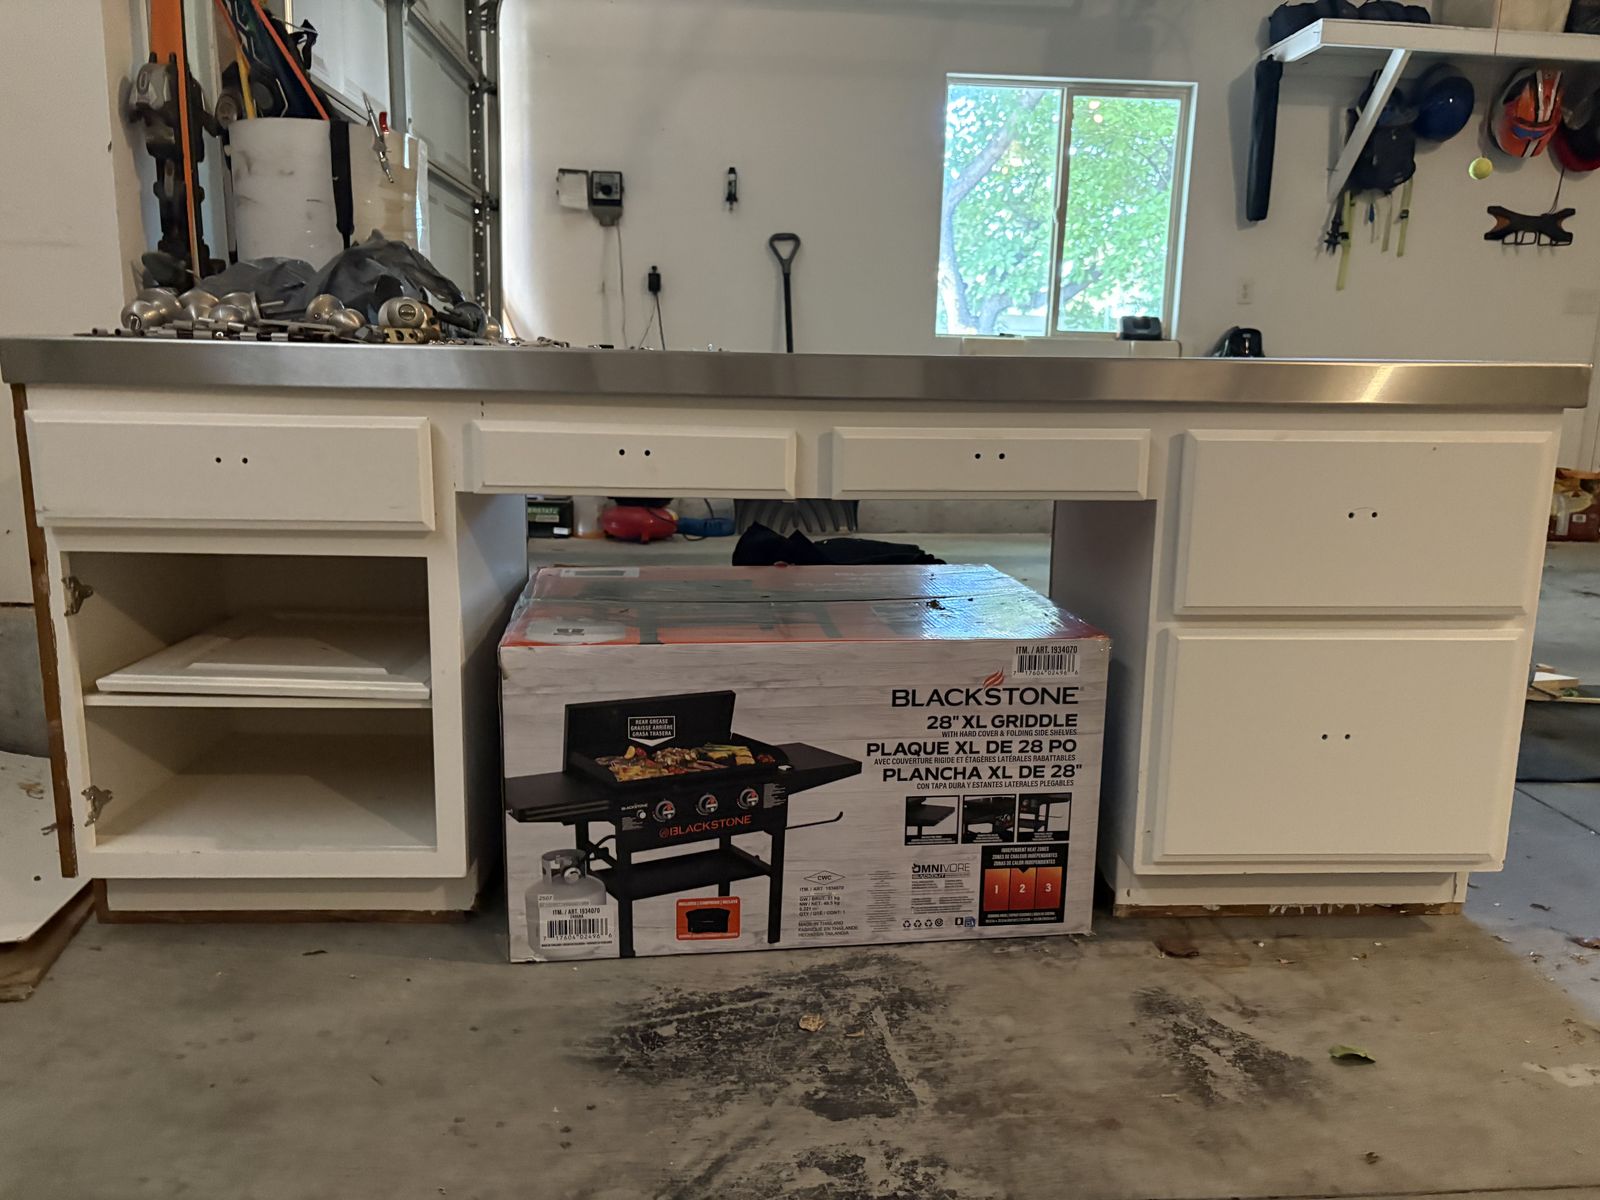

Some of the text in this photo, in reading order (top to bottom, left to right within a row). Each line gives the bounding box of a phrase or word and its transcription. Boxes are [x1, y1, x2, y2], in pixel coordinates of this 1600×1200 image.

[1016, 646, 1029, 654] ITM.
[892, 686, 1079, 707] BLACKSTONE
[927, 714, 1078, 730] 28" XL GRIDDLE
[867, 739, 1077, 757] PLAQUE XL DE 28 PO
[883, 764, 1082, 782] PLANCHA XL DE 28"
[669, 815, 752, 836] BLACKSTONE
[912, 863, 970, 873] OMNIVORE
[995, 883, 1052, 894] 1 2 3
